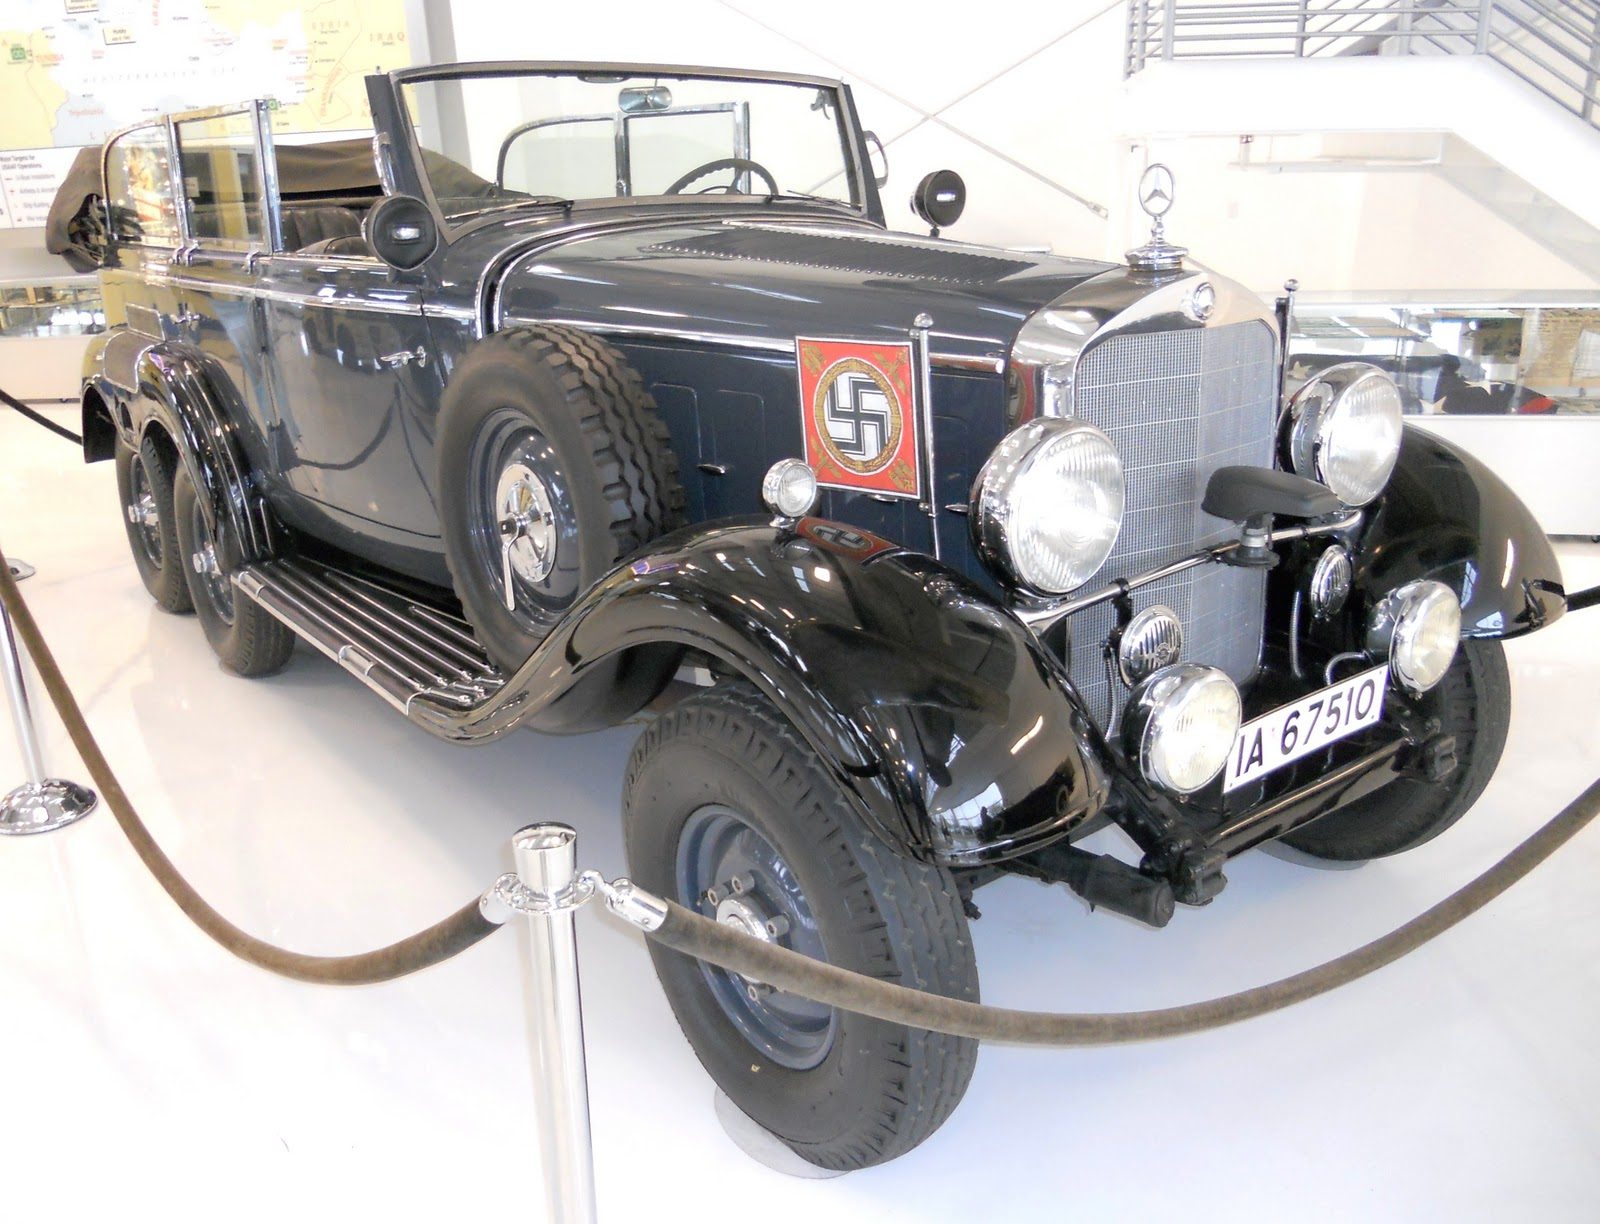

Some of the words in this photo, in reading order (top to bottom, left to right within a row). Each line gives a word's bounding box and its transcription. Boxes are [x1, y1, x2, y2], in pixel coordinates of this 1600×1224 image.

[312, 20, 350, 30] SYRIA
[369, 32, 405, 42] IRAQ
[1281, 679, 1376, 755] 67510
